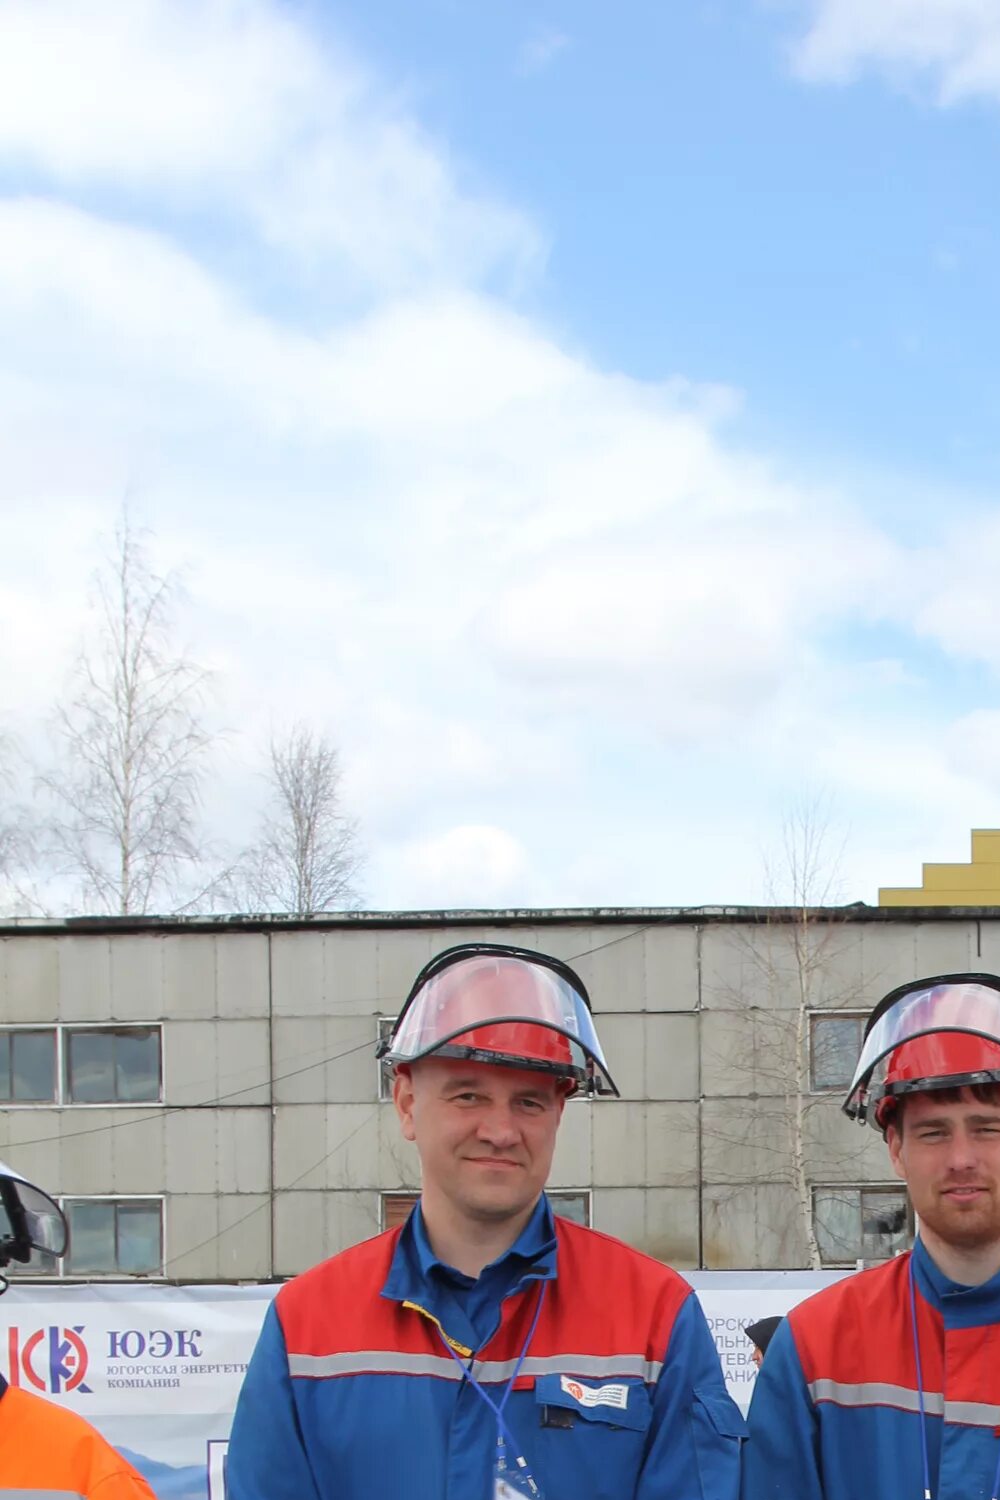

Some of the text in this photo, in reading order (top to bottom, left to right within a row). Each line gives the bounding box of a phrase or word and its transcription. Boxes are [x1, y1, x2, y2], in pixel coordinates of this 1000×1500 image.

[106, 1329, 203, 1359] ЮЭК
[106, 1364, 177, 1376] ЮГОРСКАЯ
[107, 1378, 181, 1389] КОМПАНИЯ
